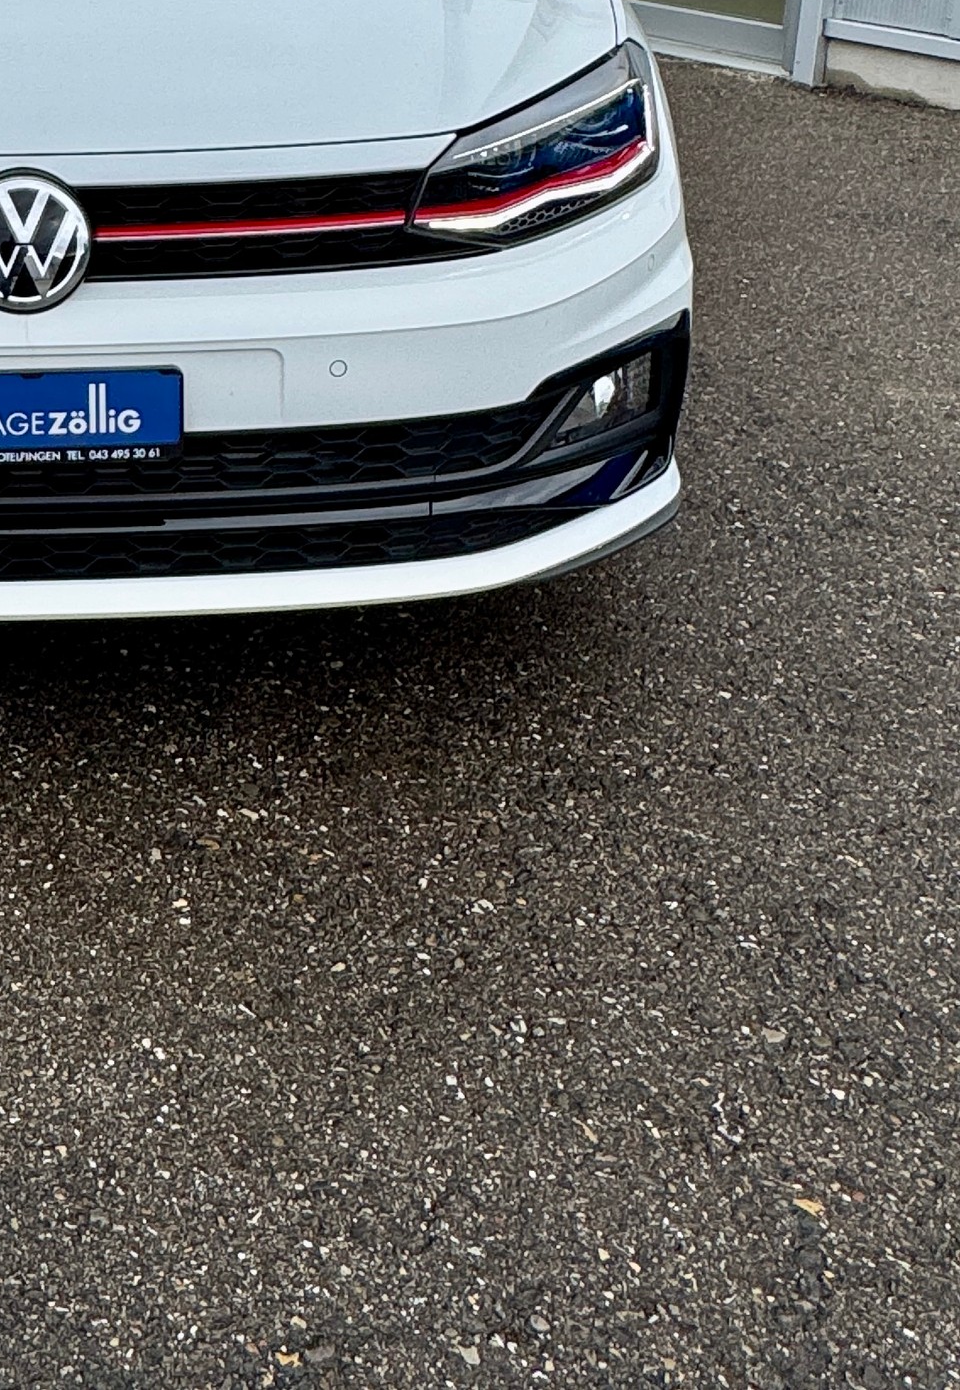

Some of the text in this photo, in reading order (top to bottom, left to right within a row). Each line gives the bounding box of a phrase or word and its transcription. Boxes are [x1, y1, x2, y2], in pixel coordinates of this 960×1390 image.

[67, 449, 86, 461] TEL
[89, 448, 109, 460] 043
[111, 448, 130, 460] 495
[133, 448, 147, 460] 30
[148, 447, 161, 459] 61
